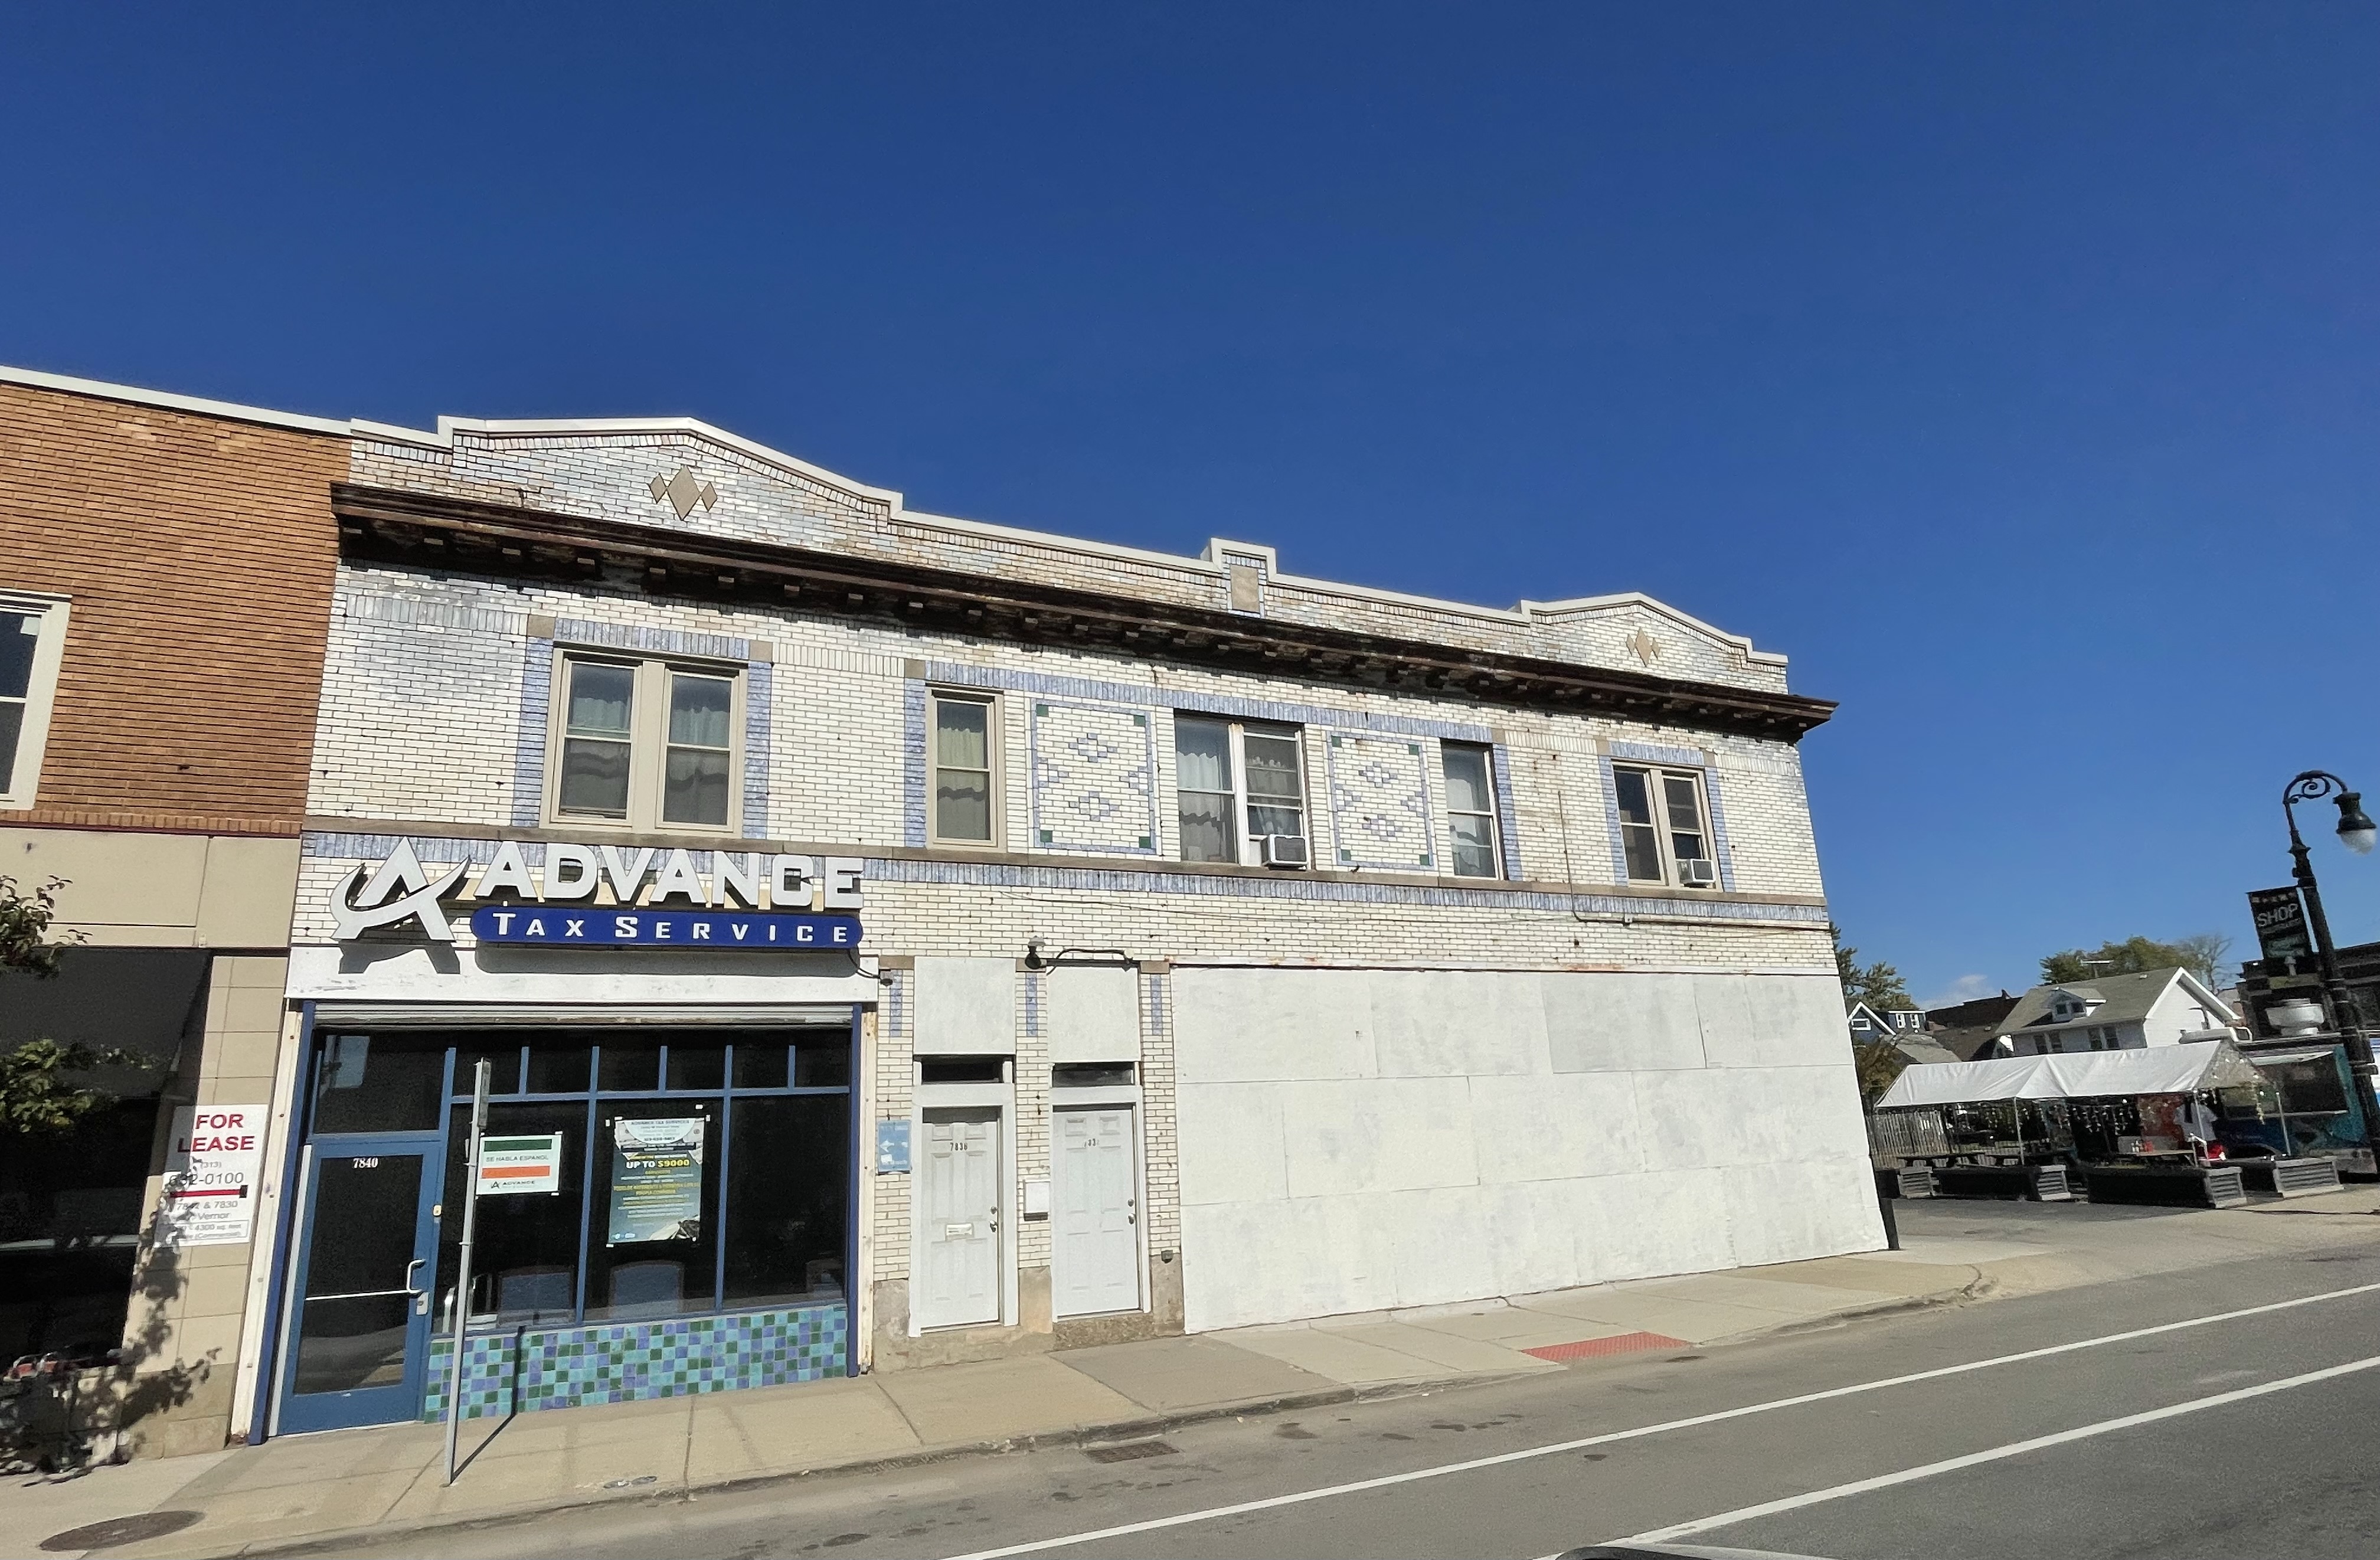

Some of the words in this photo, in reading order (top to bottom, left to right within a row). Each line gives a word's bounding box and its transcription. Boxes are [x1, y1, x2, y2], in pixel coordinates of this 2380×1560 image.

[473, 840, 864, 908] ADVANCE
[2257, 903, 2298, 927] SHOP
[492, 913, 584, 937] TAX
[614, 915, 848, 943] SERVICE
[195, 1114, 244, 1129] FOR
[177, 1136, 255, 1152] LEASE
[950, 1142, 967, 1151] 7836
[353, 1157, 378, 1169] 7840
[626, 1160, 641, 1169] UP
[642, 1160, 656, 1168] TO
